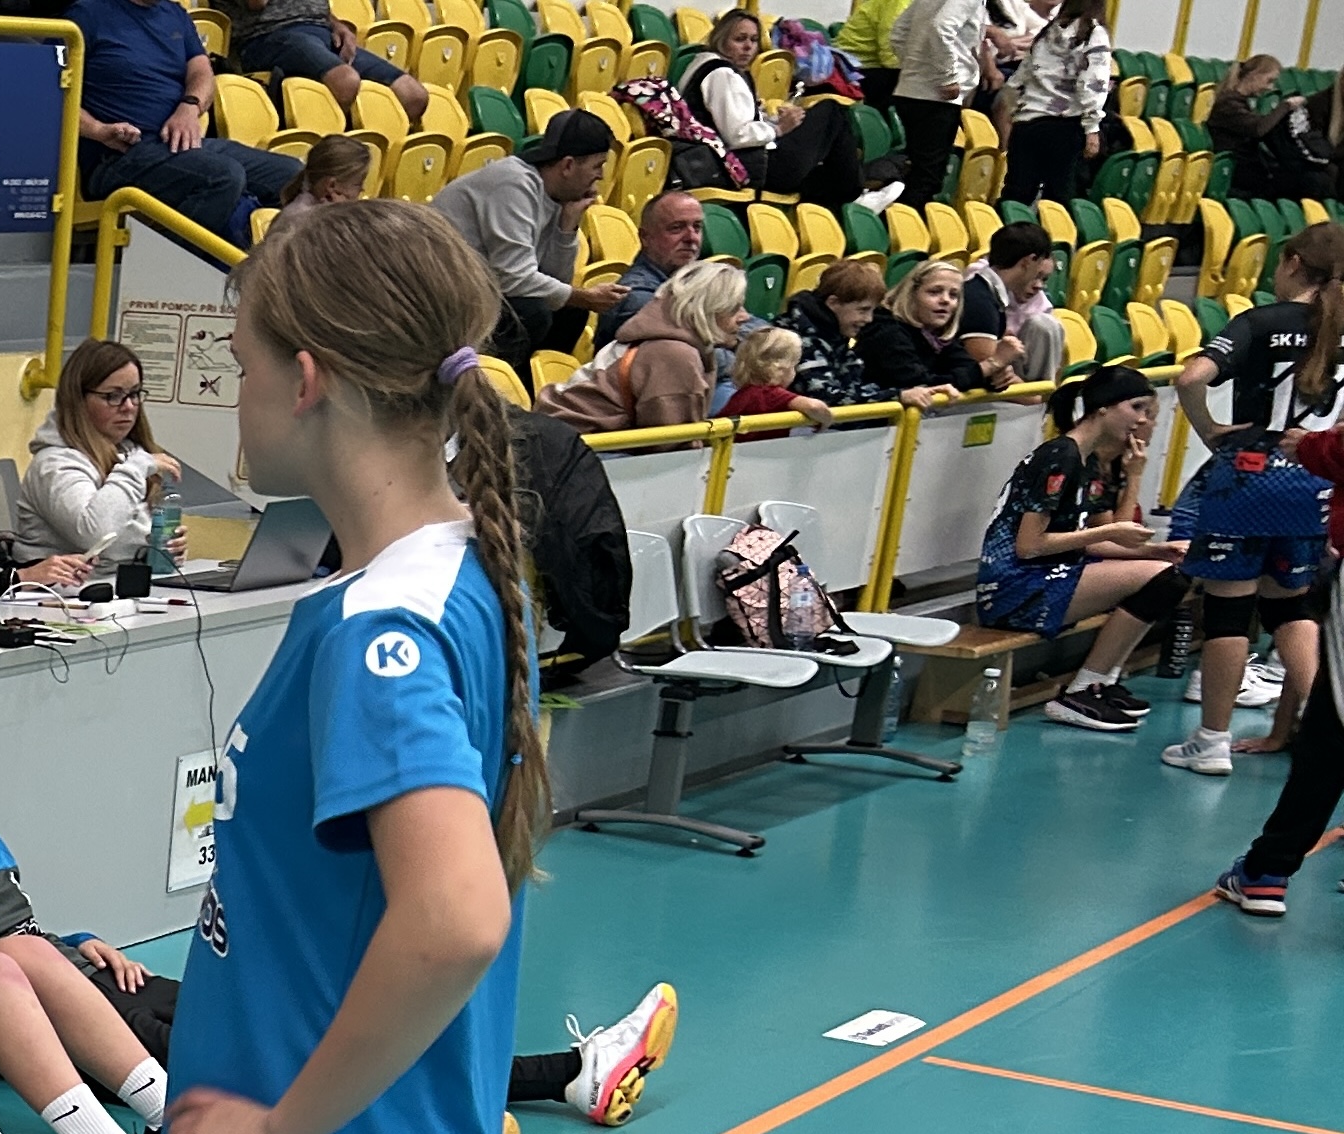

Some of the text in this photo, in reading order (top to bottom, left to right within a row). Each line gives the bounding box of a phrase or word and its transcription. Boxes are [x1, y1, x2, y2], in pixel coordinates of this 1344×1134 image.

[129, 300, 160, 311] PRVNÍ
[161, 302, 198, 313] POMOC
[1269, 333, 1292, 348] SK
[186, 765, 217, 788] MAN
